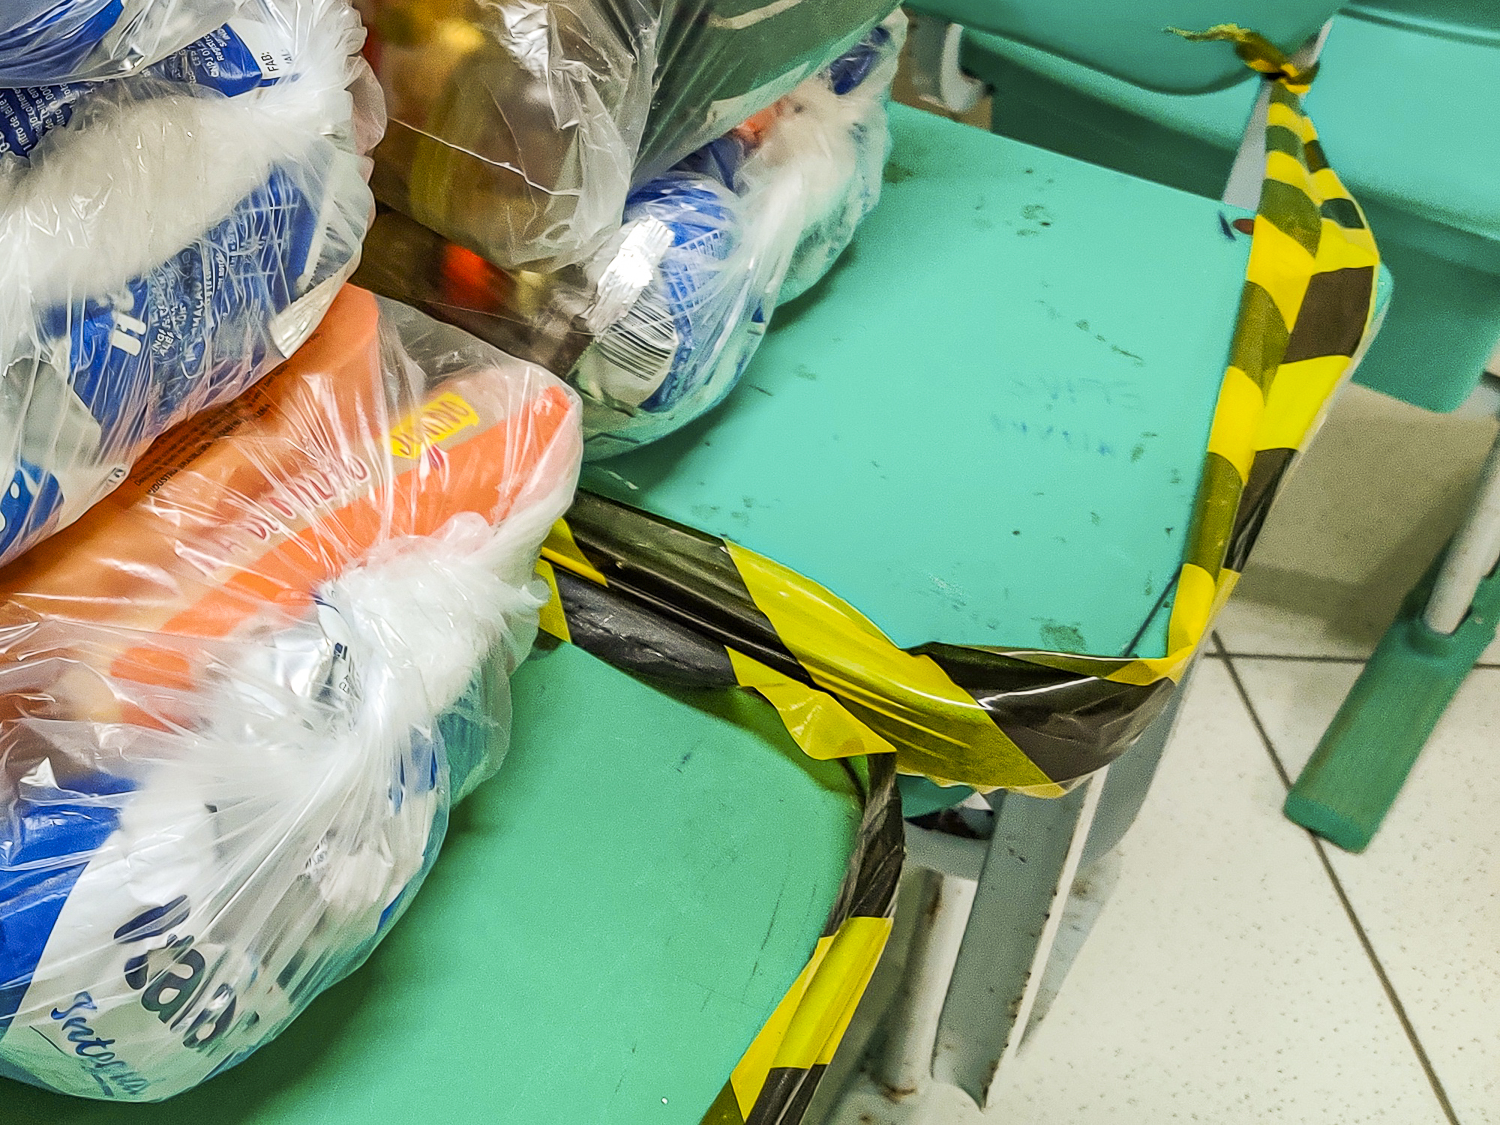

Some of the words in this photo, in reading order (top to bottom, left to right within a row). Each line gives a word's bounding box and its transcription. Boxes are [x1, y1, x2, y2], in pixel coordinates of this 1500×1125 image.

[258, 49, 279, 74] FAB:
[7, 115, 20, 128] de
[12, 126, 30, 146] litro
